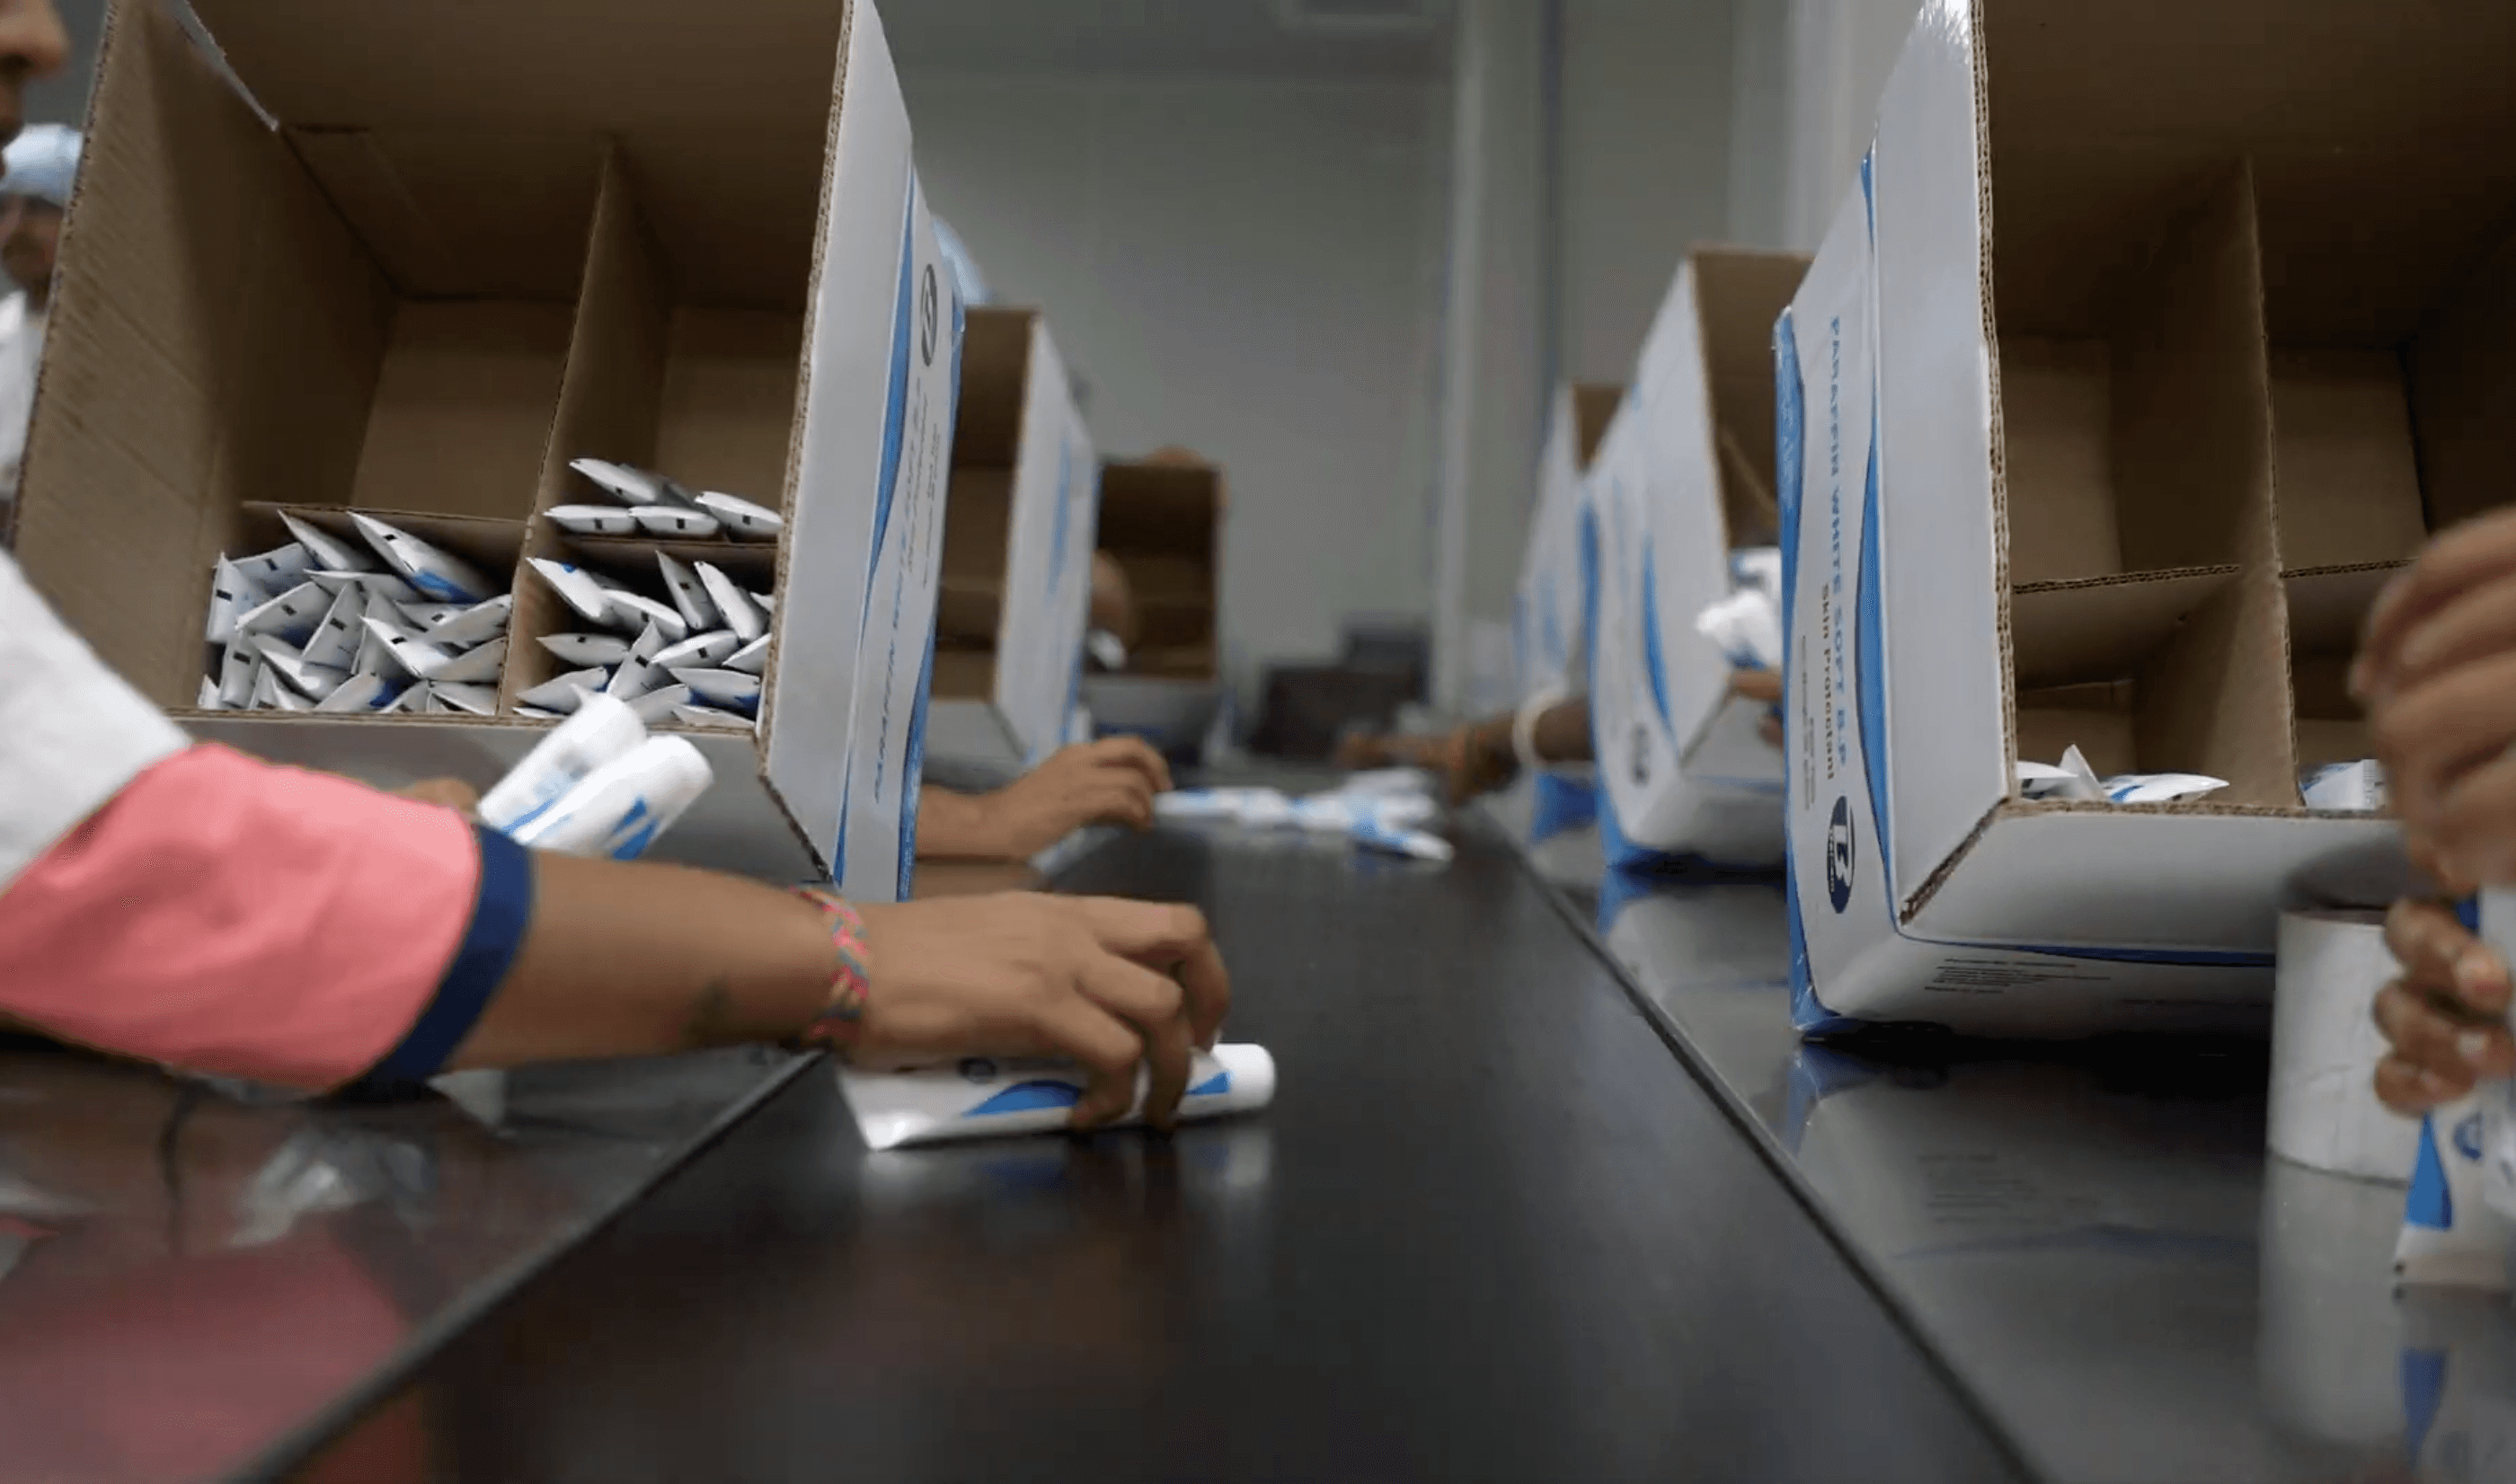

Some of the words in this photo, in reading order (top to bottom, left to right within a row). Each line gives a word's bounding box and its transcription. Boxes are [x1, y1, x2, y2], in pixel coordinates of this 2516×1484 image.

[1830, 316, 1840, 477] PARAFFIN
[1831, 486, 1843, 595] WHITE
[1821, 583, 1832, 640] Skin
[1834, 605, 1846, 694] SOFT
[1824, 648, 1835, 781] Protectant
